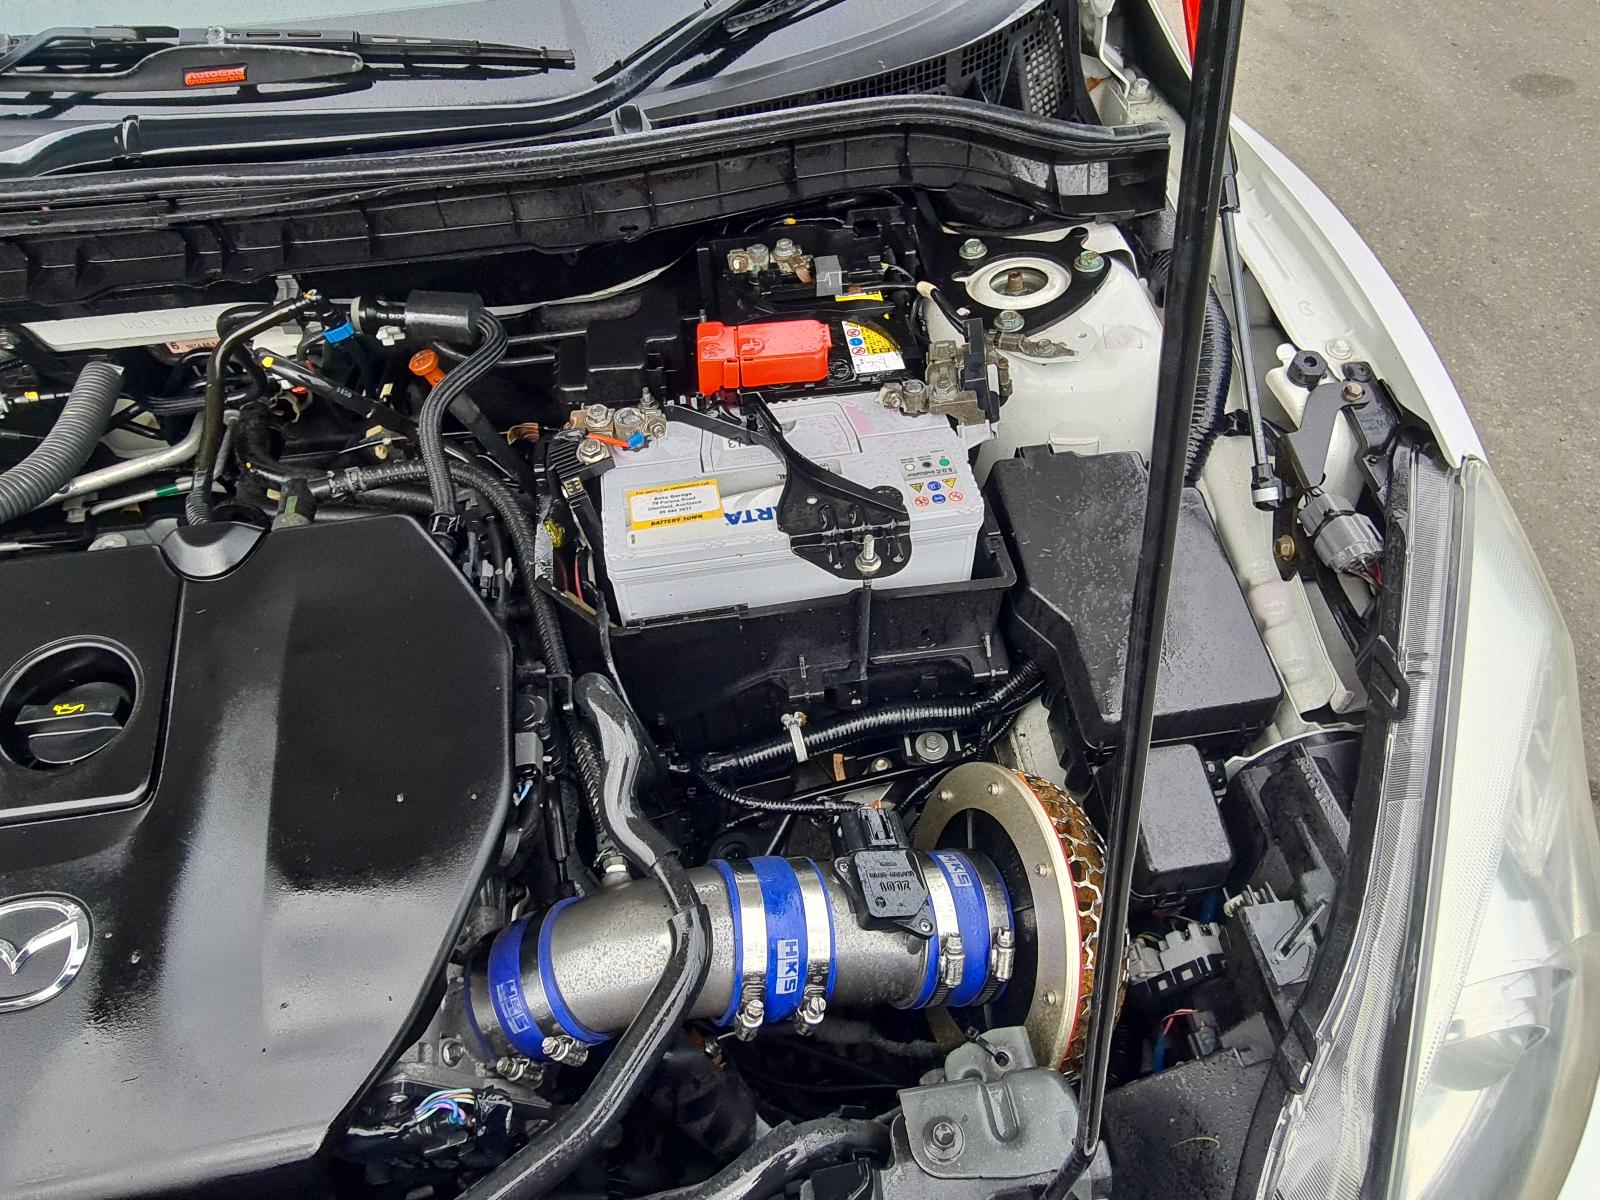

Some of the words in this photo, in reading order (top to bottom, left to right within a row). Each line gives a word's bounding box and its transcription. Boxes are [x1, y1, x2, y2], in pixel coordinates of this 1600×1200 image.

[170, 341, 180, 350] 6
[650, 517, 681, 527] BATTERY
[683, 514, 703, 522] TOWN
[939, 855, 972, 887] HKS
[777, 940, 798, 994] HKS
[498, 979, 530, 1033] HKS
